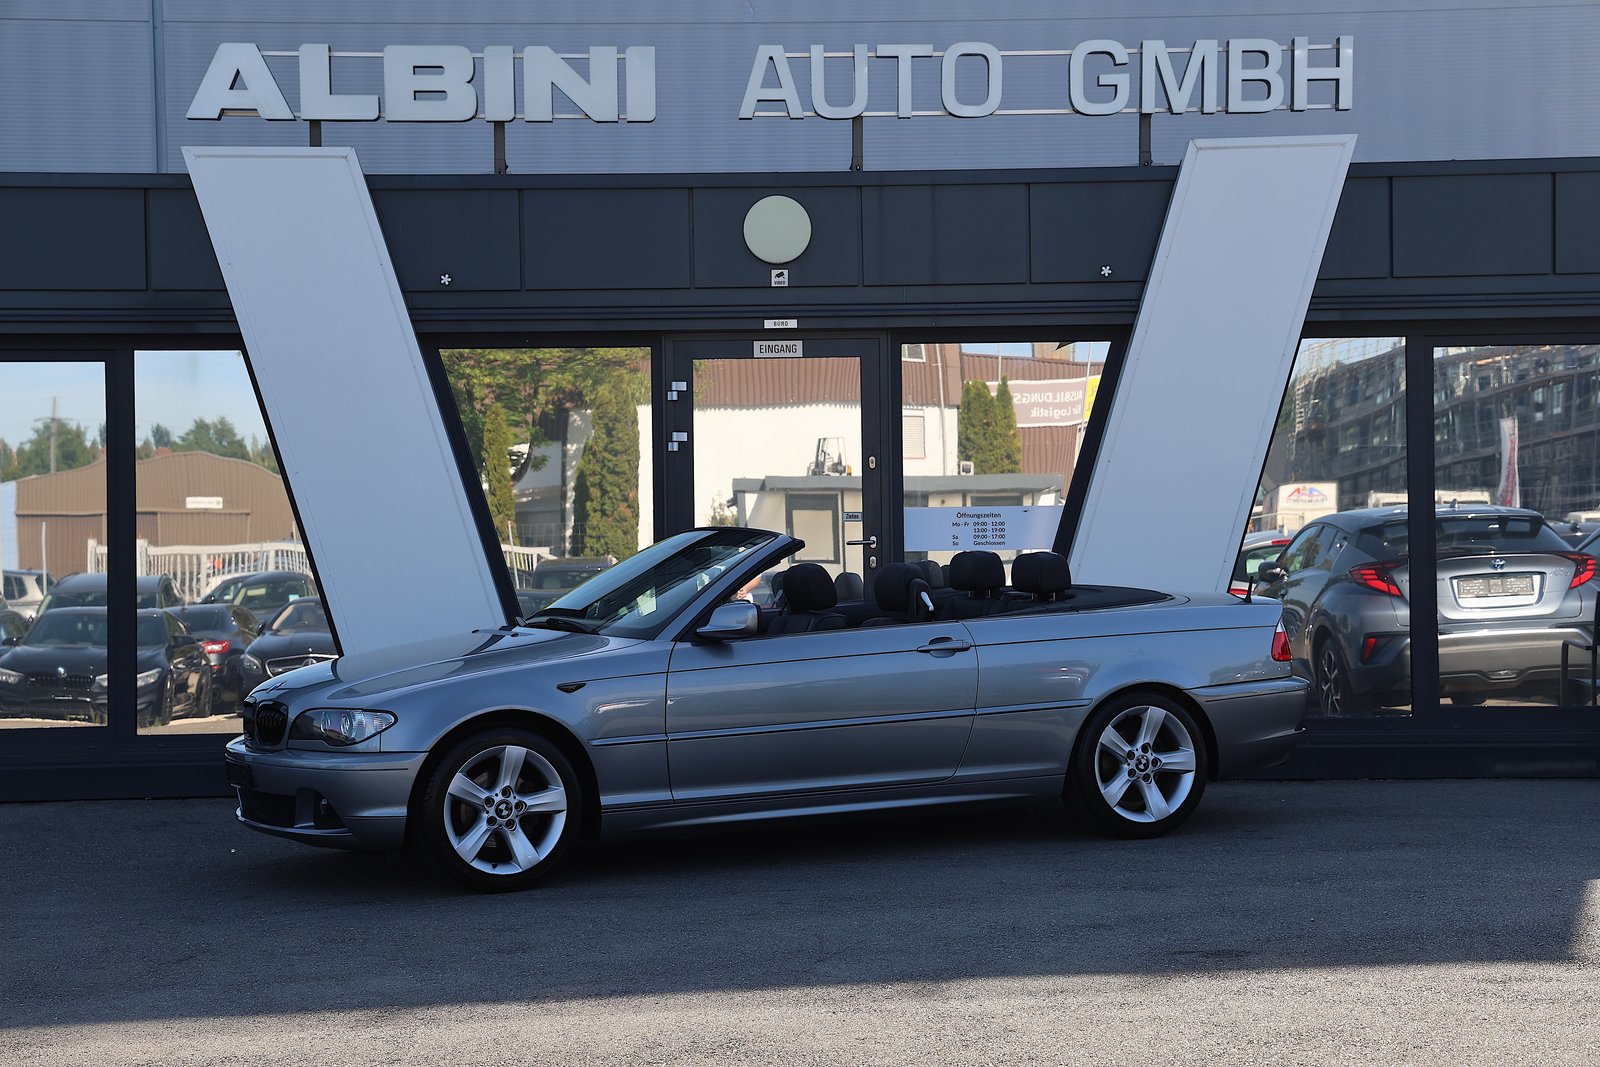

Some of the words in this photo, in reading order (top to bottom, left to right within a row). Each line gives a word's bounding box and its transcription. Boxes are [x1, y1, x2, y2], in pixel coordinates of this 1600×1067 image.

[185, 42, 657, 122] ALBINI
[738, 41, 1003, 120] AUTO
[1068, 35, 1354, 116] GMBH
[759, 344, 797, 354] EINGANG
